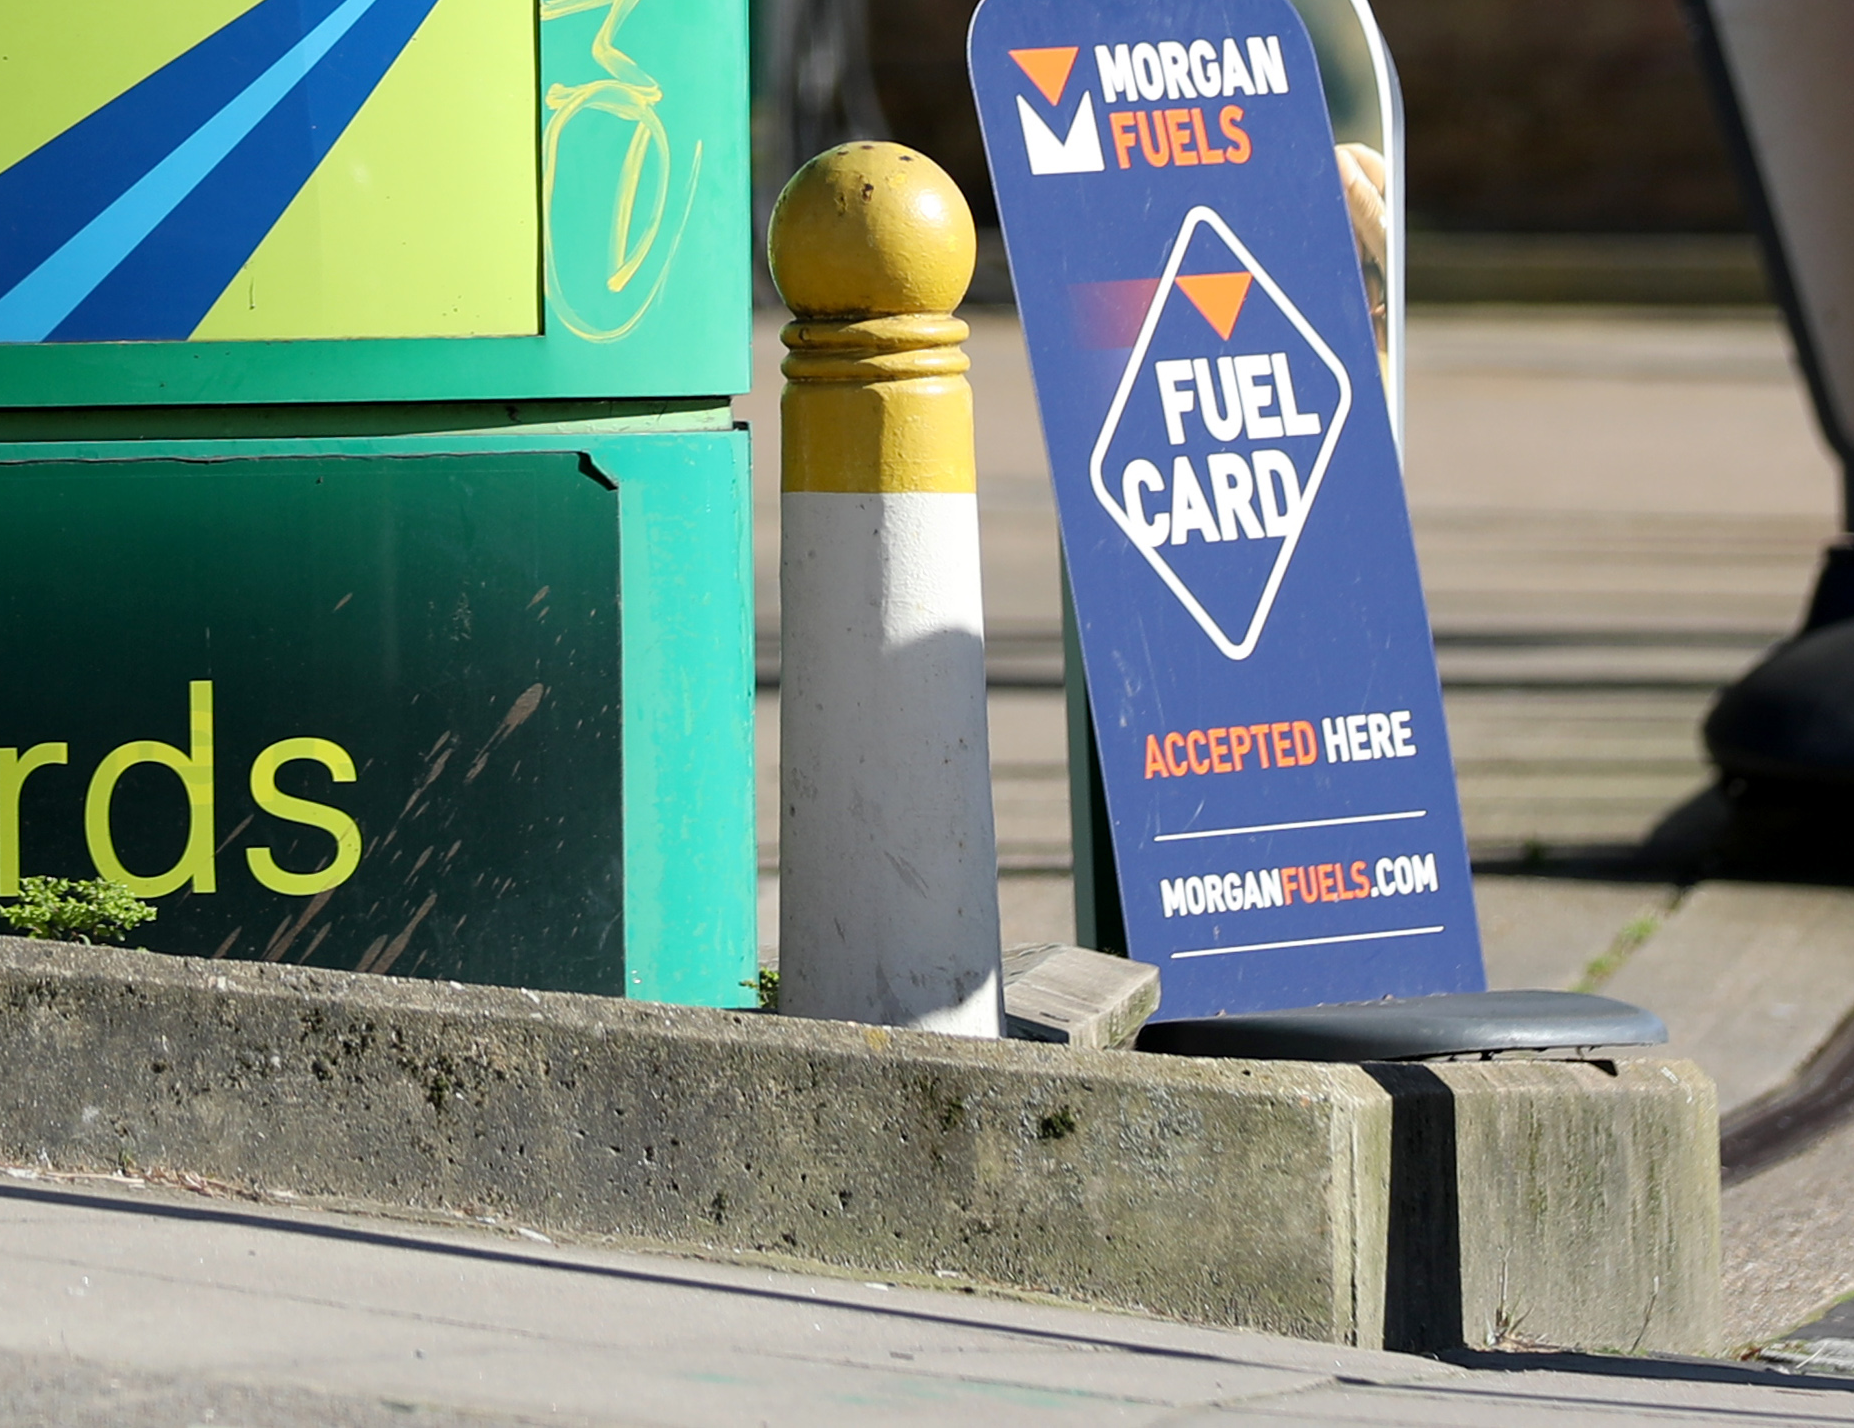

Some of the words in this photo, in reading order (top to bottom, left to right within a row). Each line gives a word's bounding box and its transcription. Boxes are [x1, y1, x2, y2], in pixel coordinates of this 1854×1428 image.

[1094, 34, 1289, 105] MORGAN
[1109, 105, 1253, 170] FUELS
[1155, 351, 1322, 446] FUEL
[1121, 448, 1302, 551] CARD
[1144, 720, 1318, 780] ACCEPTED
[1322, 710, 1418, 765] HERE
[1159, 852, 1440, 920] MORGANFUELS.COM
